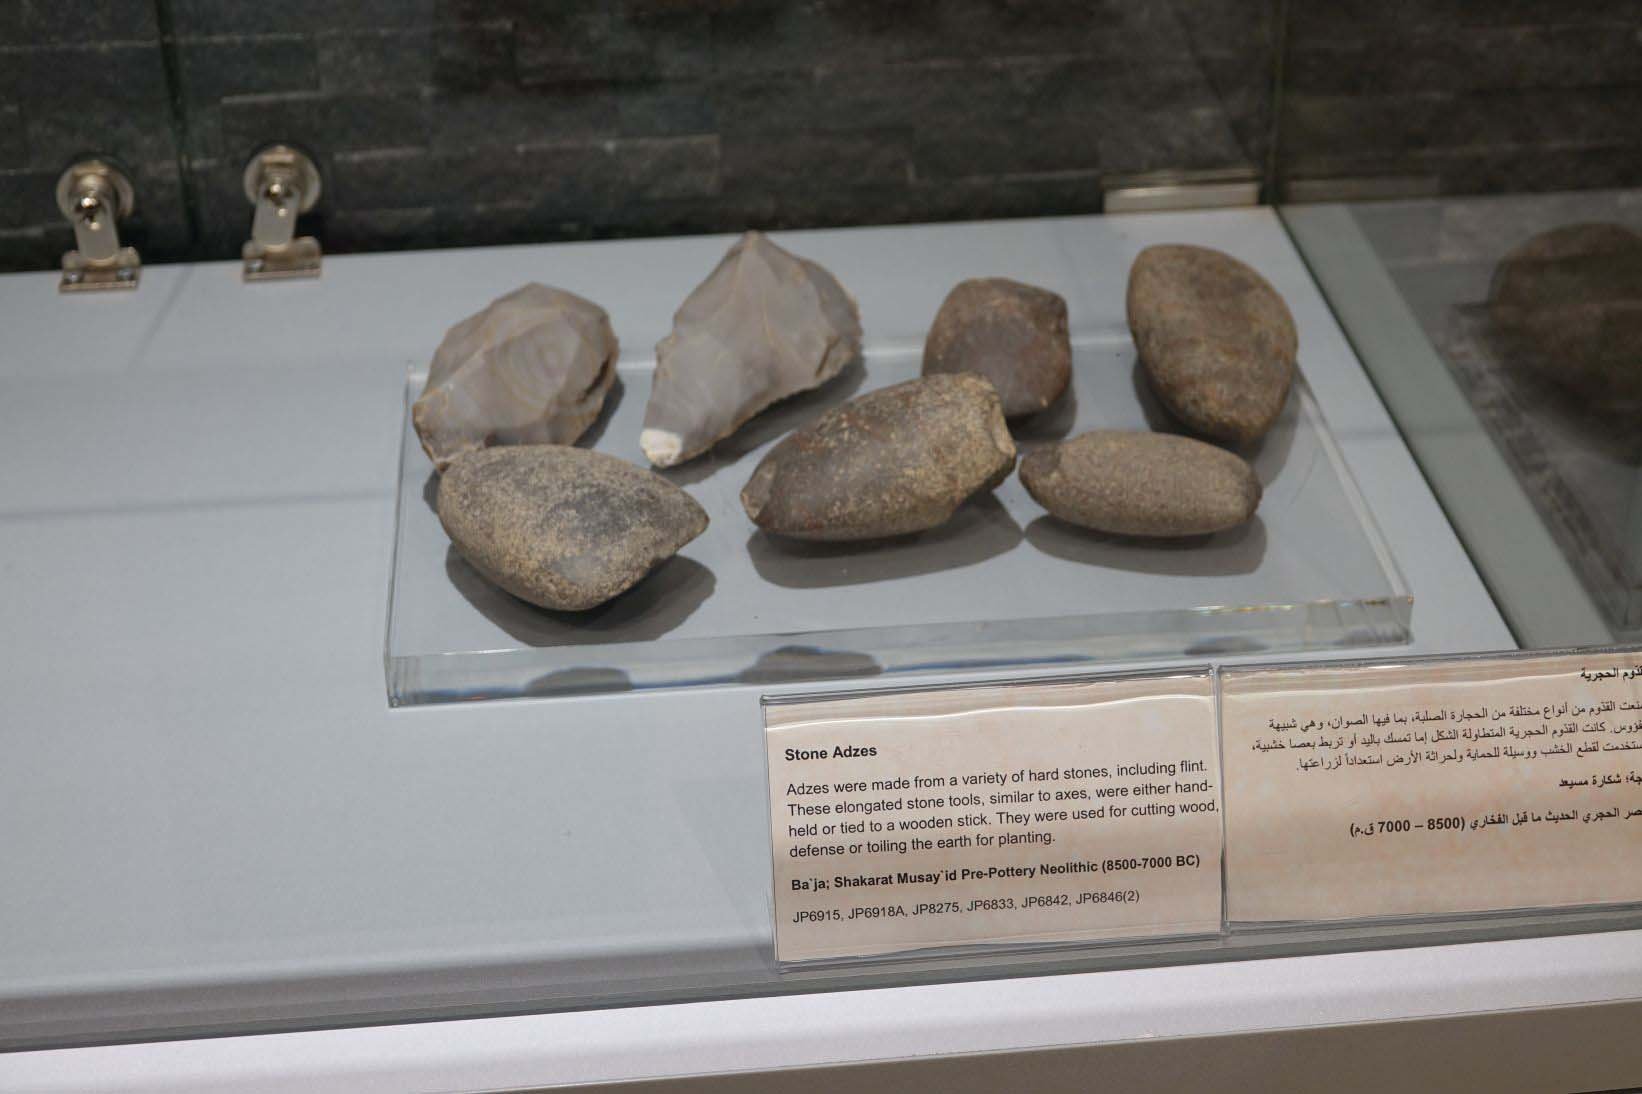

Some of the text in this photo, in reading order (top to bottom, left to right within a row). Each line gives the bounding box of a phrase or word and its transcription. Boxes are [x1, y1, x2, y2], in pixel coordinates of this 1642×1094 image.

[1580, 667, 1619, 682] الحجرية
[1509, 706, 1540, 716] مختلفة
[1543, 702, 1568, 719] أنواع
[1571, 704, 1586, 716] من
[1619, 701, 1642, 710] نعت
[1372, 713, 1391, 727] فيها
[1393, 713, 1408, 725] بما
[1411, 710, 1447, 723] الصلبة،
[1450, 707, 1487, 723] الحجارة
[1491, 709, 1506, 721] من
[1269, 718, 1297, 731] شبيهة
[1300, 719, 1323, 732] وهي
[1582, 722, 1605, 733] كانت
[1384, 733, 1411, 744] تمسك
[1431, 729, 1459, 743] الشكل
[1462, 726, 1506, 742] المتطاولة
[1509, 725, 1548, 740] الحجرية
[1252, 740, 1285, 752] خشبية،
[1289, 739, 1316, 750] بعصا
[1318, 738, 1344, 750] تربط
[1360, 733, 1381, 747] باليد
[785, 746, 877, 761] Stone Adzes
[1467, 748, 1500, 761] للحماية
[1503, 746, 1537, 759] ووسيلة
[1541, 744, 1572, 755] الخشب
[1576, 742, 1600, 757] لقطع
[1296, 754, 1343, 771] لزراعتها.
[1386, 750, 1421, 767] الأرض
[1425, 750, 1464, 764] ولحراثة
[786, 761, 1207, 796] Adzes were made from a variety of hard stones, including flint.
[1592, 774, 1622, 788] شكارة
[787, 780, 1214, 816] These elongated stone tools, similar to axes, were either hand-
[788, 800, 1219, 836] held or tied to a wooden stick. They were used for cutting wood,
[1470, 814, 1508, 830] الفخاري
[1512, 811, 1528, 826] قبل
[1531, 811, 1542, 822] ما
[1545, 809, 1578, 824] الحديث
[1582, 808, 1620, 823] الحجري
[1377, 820, 1411, 833] 7000
[789, 832, 1055, 857] defense or toiling the earth for planting.
[834, 874, 893, 888] Shakarat
[961, 866, 1036, 881] Pre-Pottery
[1040, 861, 1098, 874] Neolithic
[1102, 858, 1172, 873] (8500-7000
[1176, 854, 1200, 868] BC)
[792, 890, 1140, 923] JP6915, JP6918A, JP8275, JP6833, JP6842, JP6846(2)
